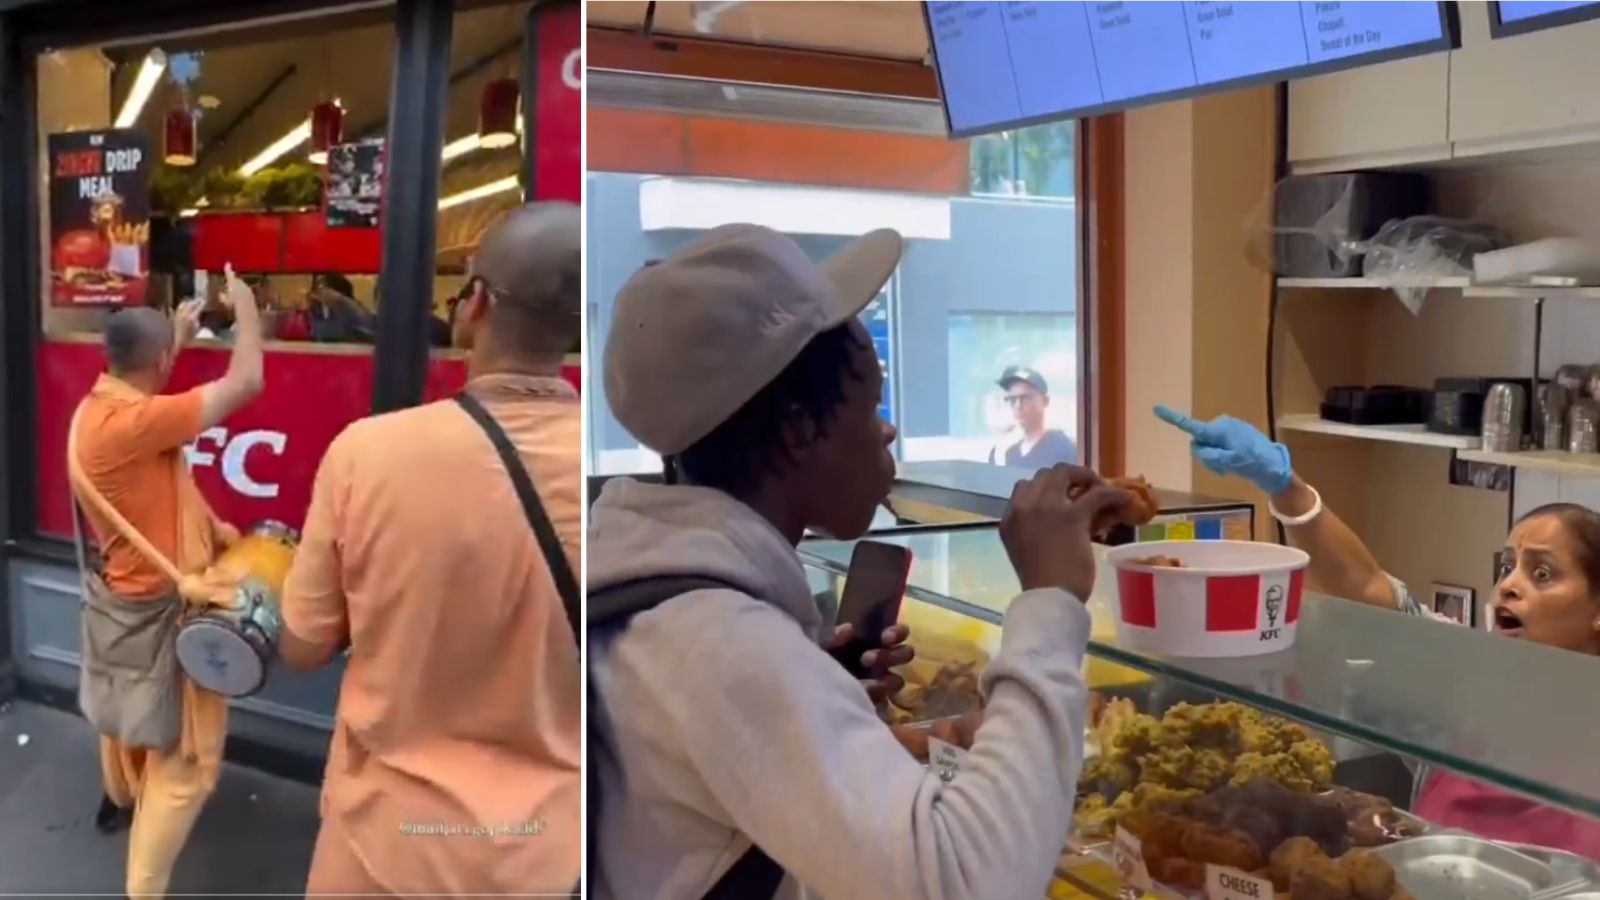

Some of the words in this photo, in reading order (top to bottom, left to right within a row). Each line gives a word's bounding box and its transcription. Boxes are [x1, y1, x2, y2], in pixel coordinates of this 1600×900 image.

[105, 148, 142, 173] DRIP
[79, 175, 114, 199] MEAL
[183, 426, 287, 498] FC
[1259, 628, 1281, 642] KFC
[1218, 873, 1260, 898] CHEESE
